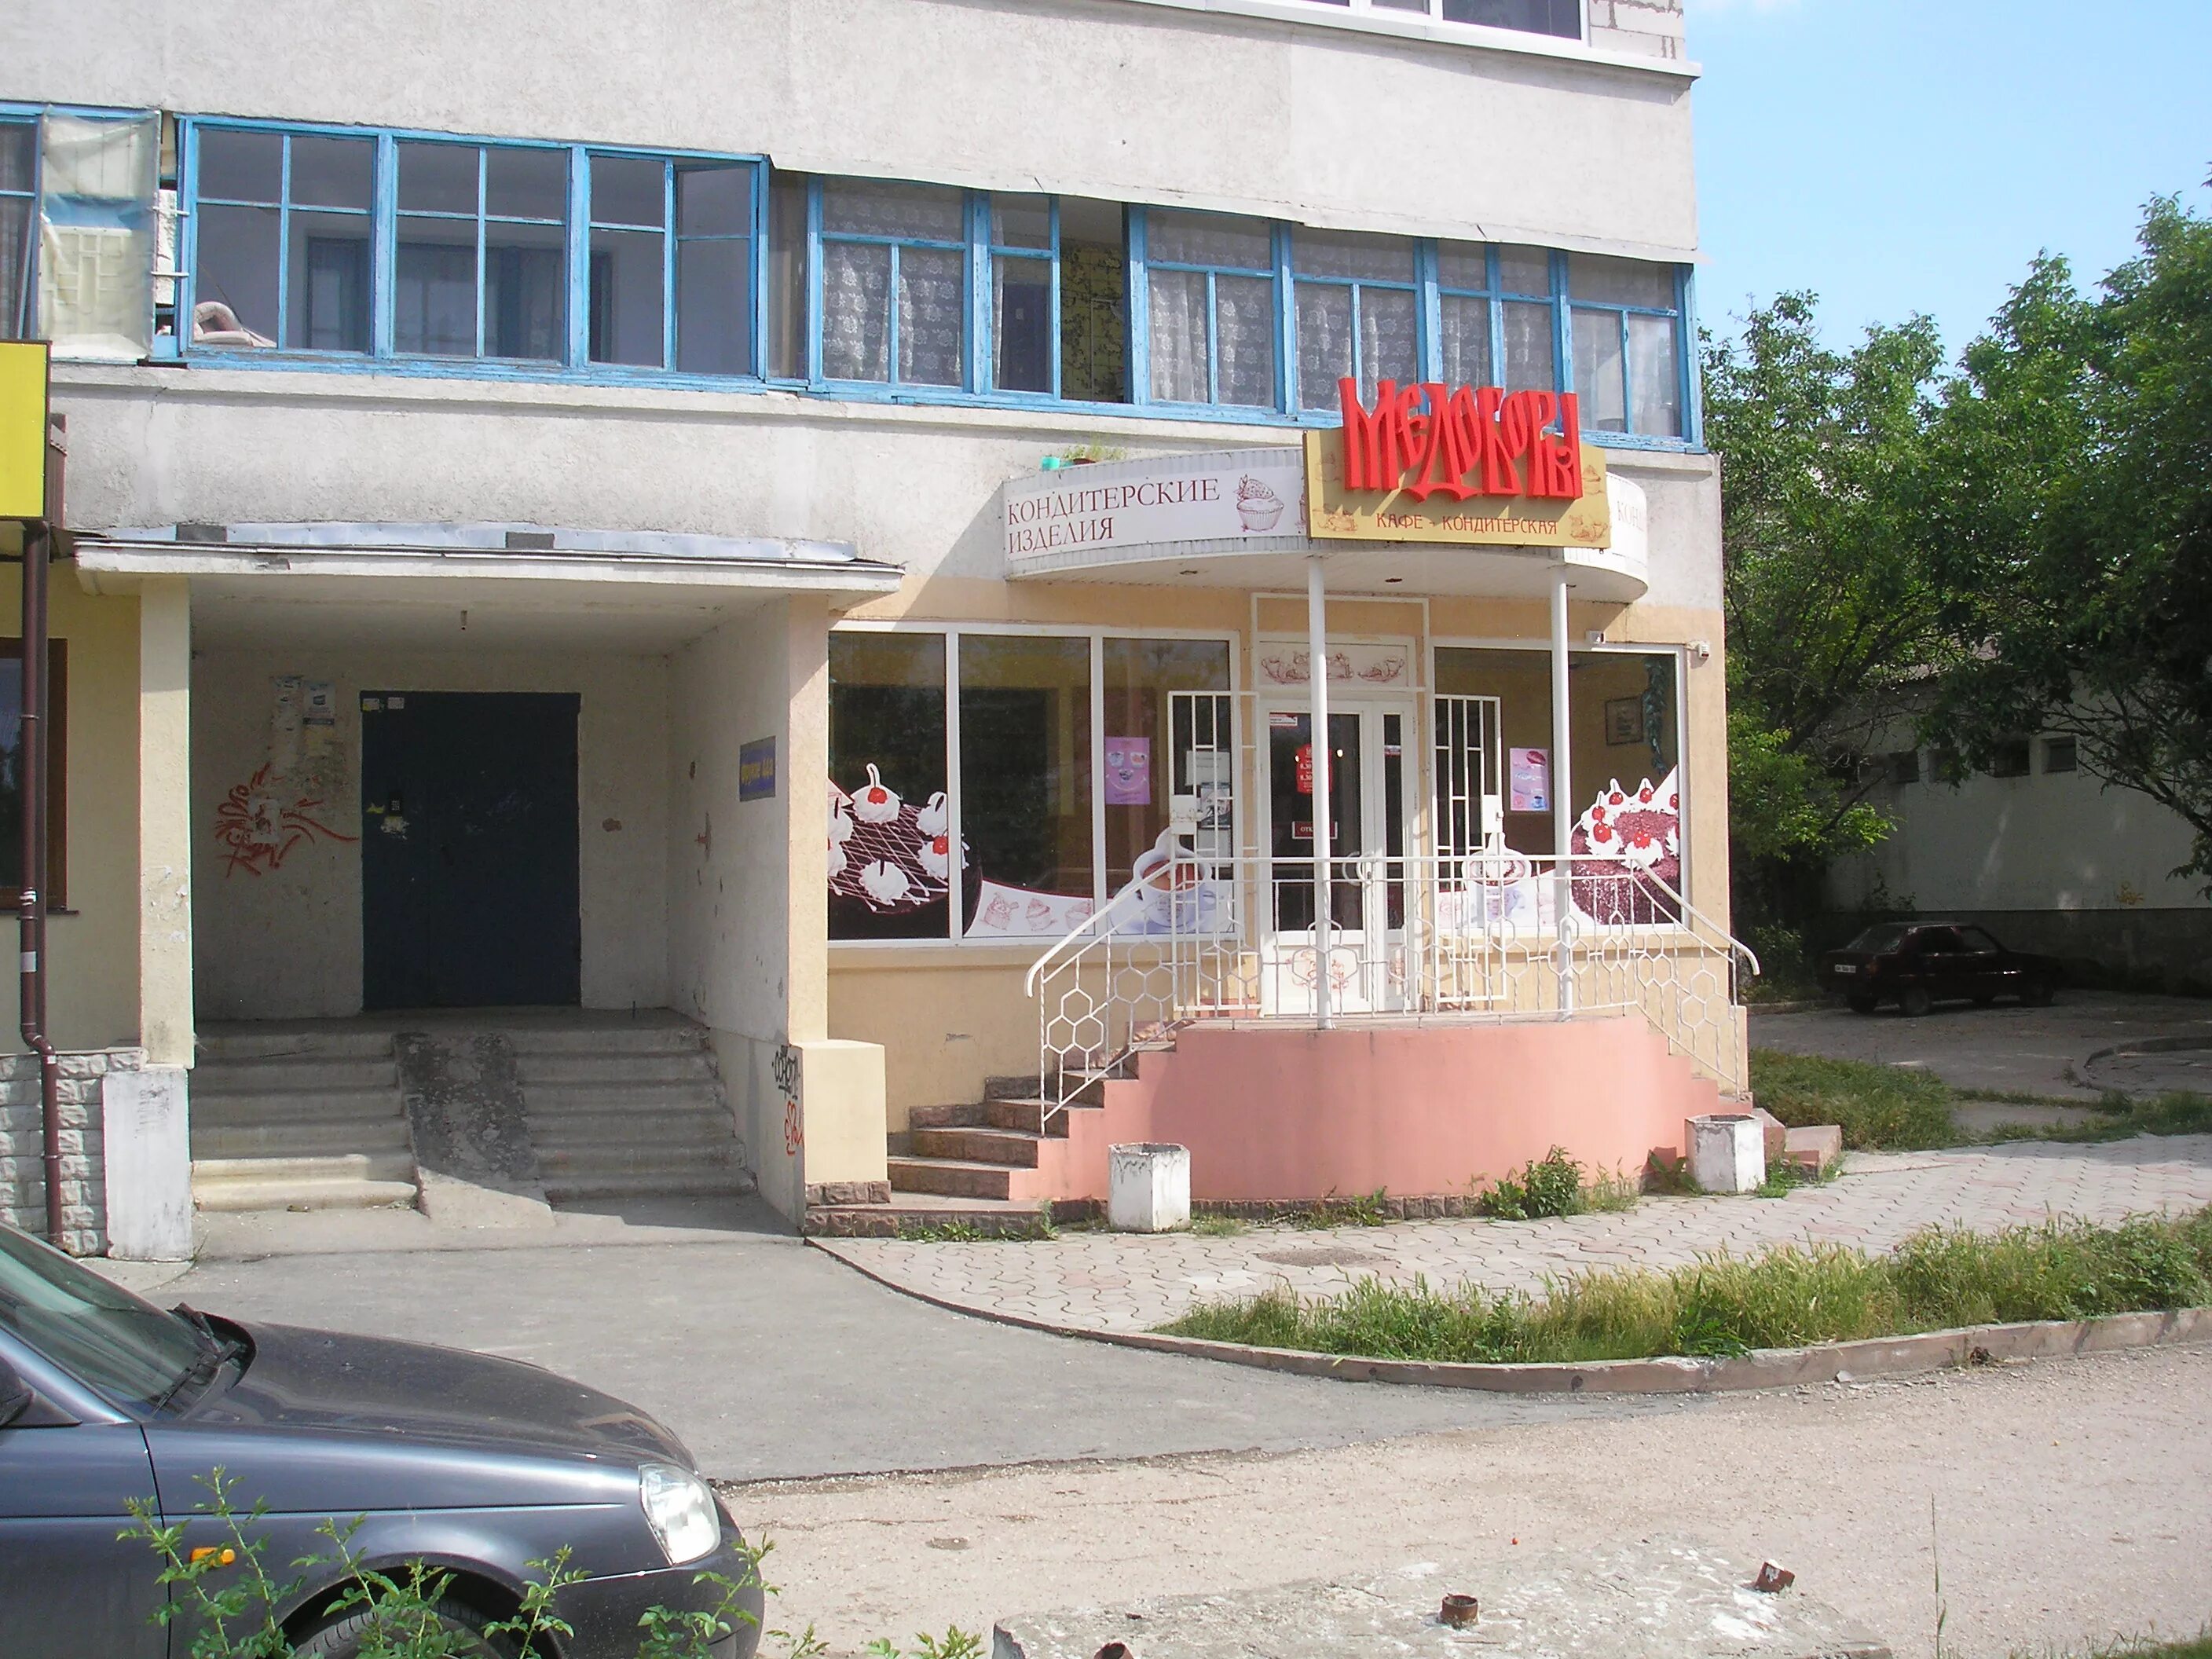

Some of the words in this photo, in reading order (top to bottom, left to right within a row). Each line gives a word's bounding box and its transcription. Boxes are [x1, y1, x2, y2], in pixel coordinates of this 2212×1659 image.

[1008, 478, 1221, 526] КОНДИТЕРСКИЕ
[1009, 517, 1115, 555] ИЗДЕЛИЯ
[1376, 513, 1423, 529] КАФЕ
[1442, 516, 1558, 536] КОНДИТЕРСКАЯ
